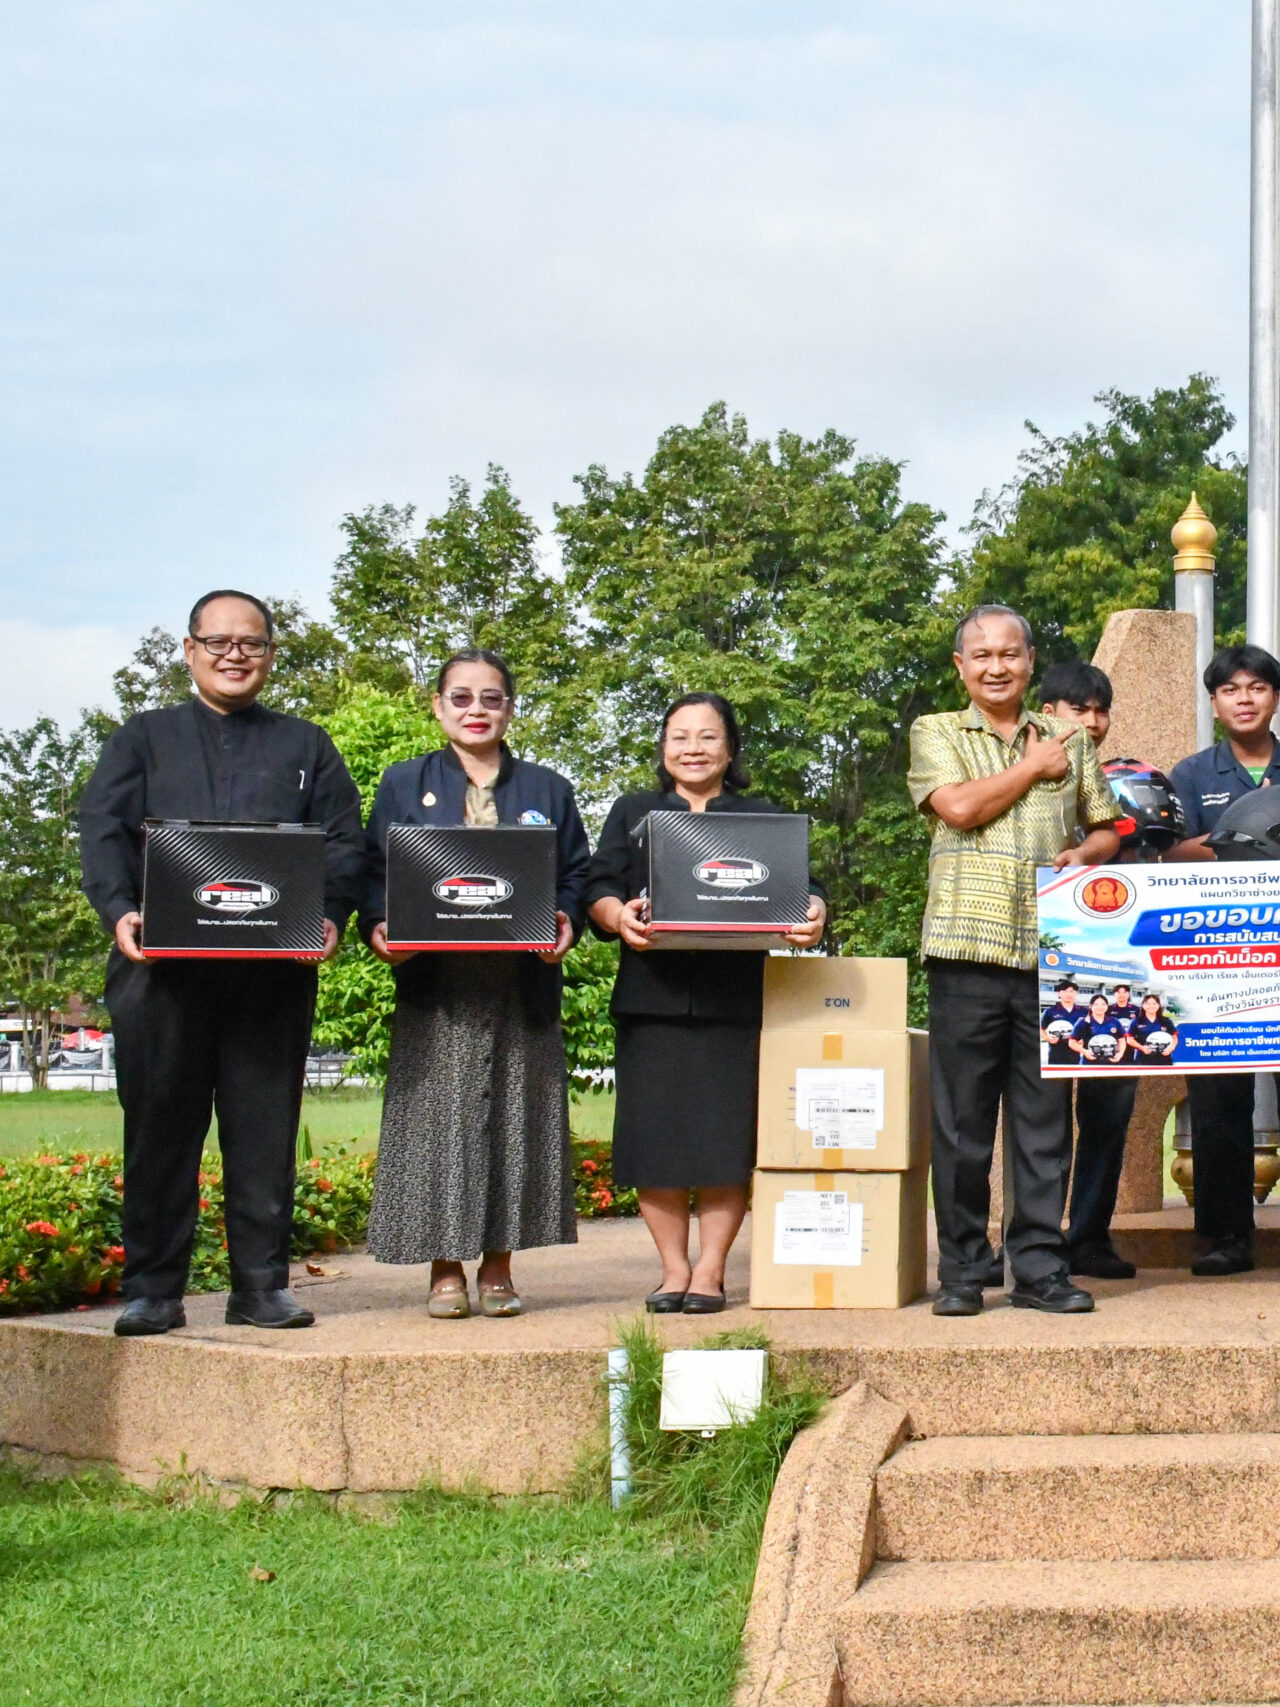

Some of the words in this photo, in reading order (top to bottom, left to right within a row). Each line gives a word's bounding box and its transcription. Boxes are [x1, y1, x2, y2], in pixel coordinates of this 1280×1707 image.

[201, 885, 272, 901] real
[439, 880, 506, 896] real
[1161, 947, 1277, 966] หมวกกันน็อค
[1189, 972, 1214, 980] บริษัท
[1217, 971, 1238, 980] เรียล
[824, 998, 850, 1008] NO.2
